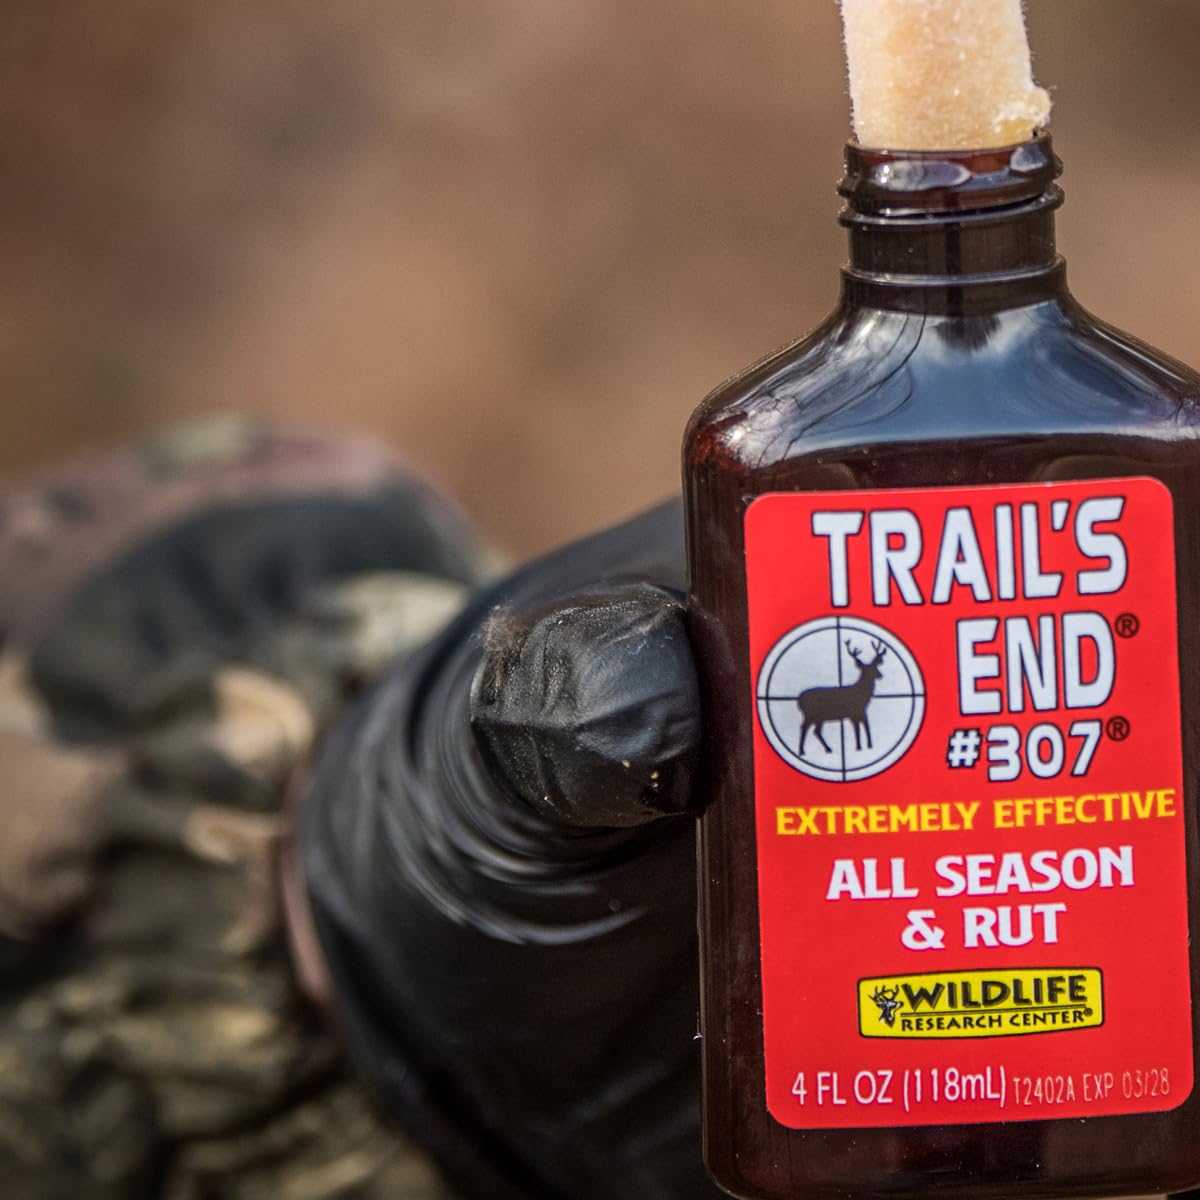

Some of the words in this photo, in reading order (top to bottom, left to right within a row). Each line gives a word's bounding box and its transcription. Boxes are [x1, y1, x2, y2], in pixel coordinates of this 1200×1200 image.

[811, 497, 1128, 607] TRAIL'S
[775, 802, 981, 836] EXTREMELY
[993, 789, 1177, 829] EFFECTIVE
[826, 857, 918, 900] ALL
[935, 845, 1135, 897] SEASON
[901, 909, 945, 950] &
[963, 902, 1068, 948] RUT
[901, 974, 1089, 1012] WILDLIFE
[900, 1013, 1002, 1032] RESEARCH
[791, 1071, 808, 1105] 4
[816, 1072, 847, 1105] FL
[853, 1070, 893, 1104] OZ
[903, 1065, 1007, 1112] (118mL)
[1012, 1076, 1076, 1106] T2402A
[1083, 1072, 1114, 1102] EXP
